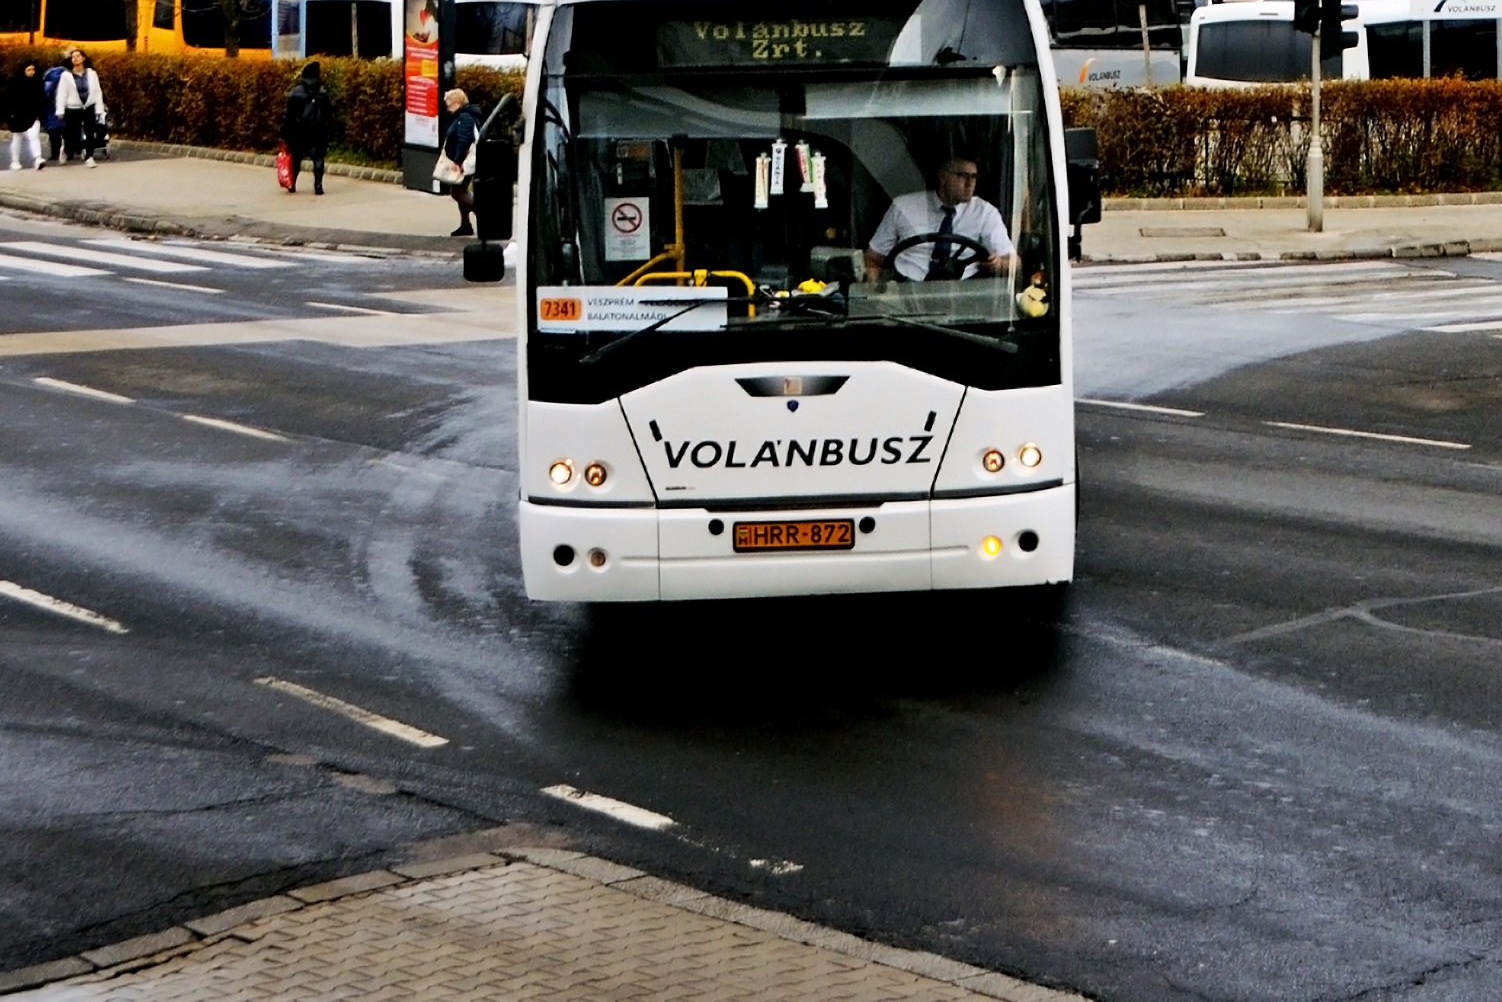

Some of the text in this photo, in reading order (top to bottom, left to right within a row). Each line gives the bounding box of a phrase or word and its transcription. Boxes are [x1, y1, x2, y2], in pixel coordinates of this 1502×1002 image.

[693, 20, 866, 40] Volánbusz
[752, 39, 823, 59] Zrt.
[544, 301, 576, 317] 7341
[587, 298, 635, 307] VESZPRÉM
[664, 435, 933, 468] VOLÁNBUSZ
[753, 524, 850, 545] HRR-872
